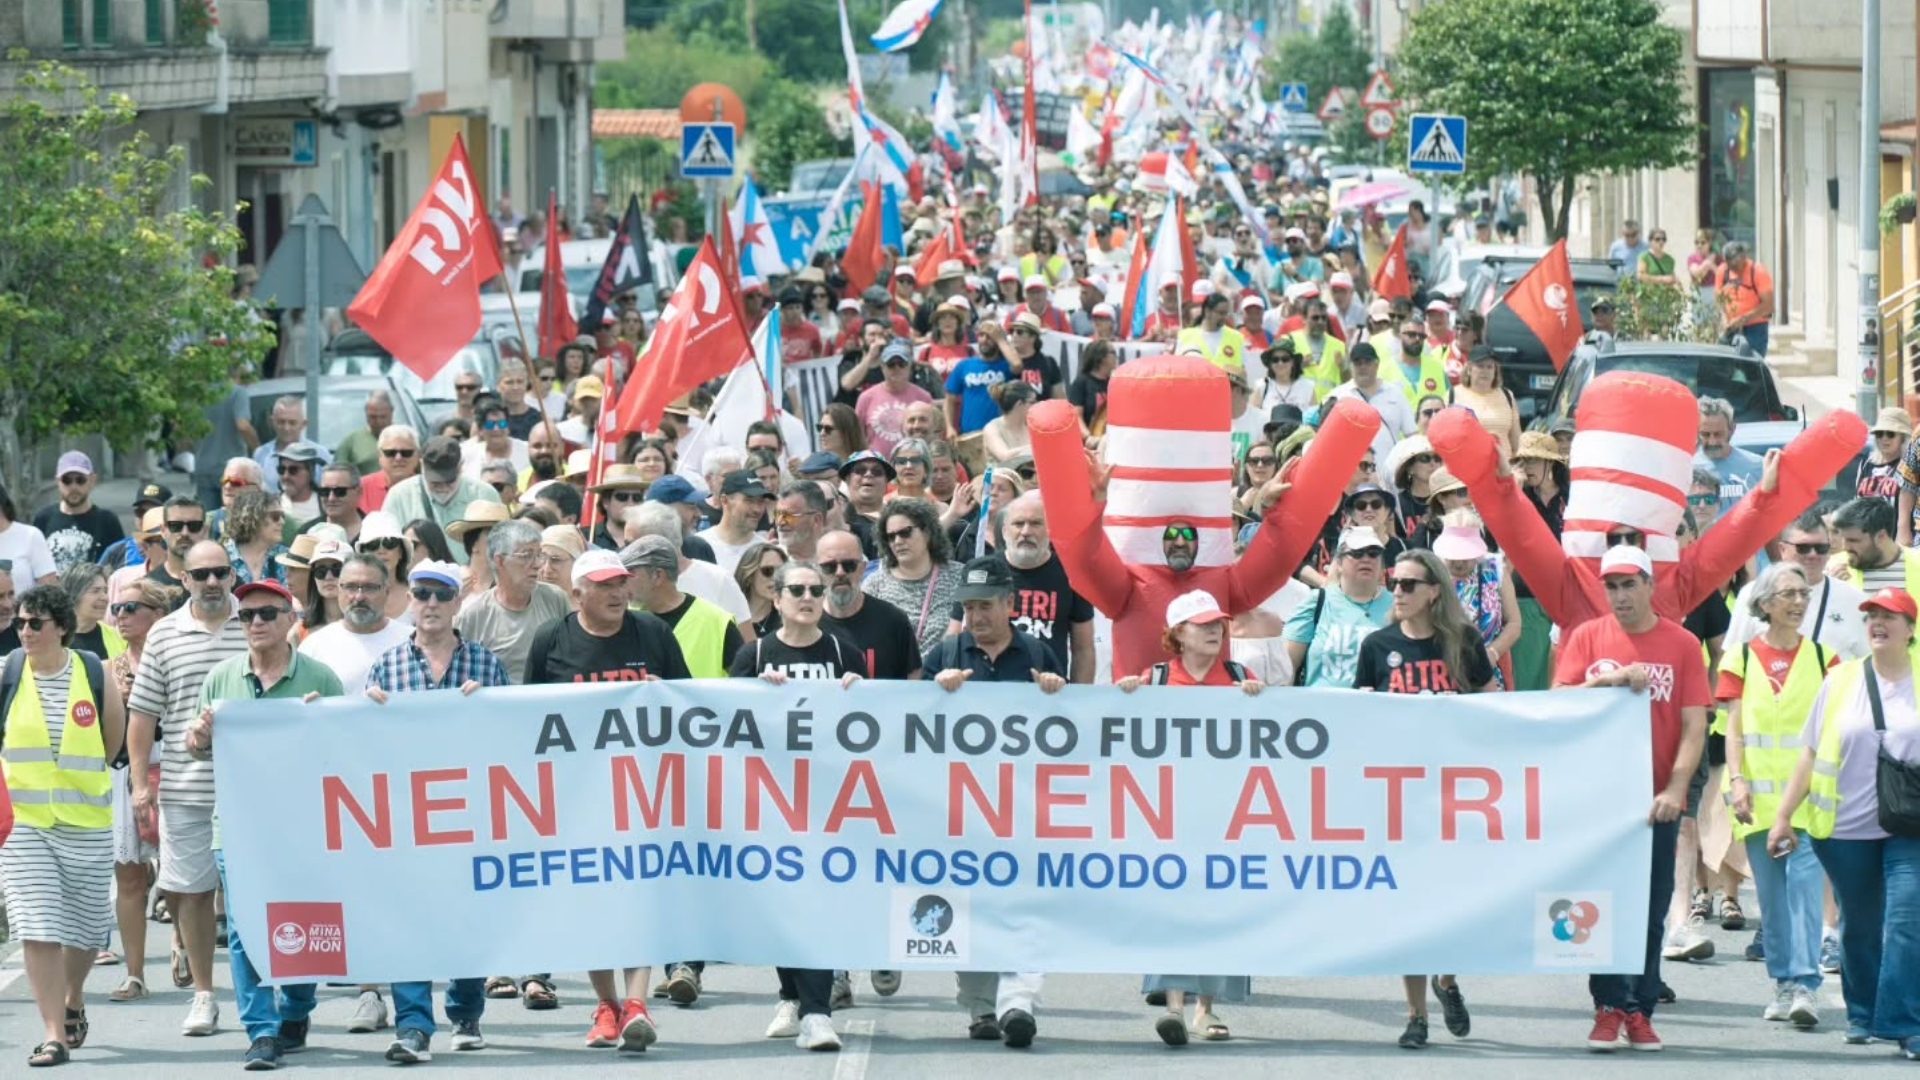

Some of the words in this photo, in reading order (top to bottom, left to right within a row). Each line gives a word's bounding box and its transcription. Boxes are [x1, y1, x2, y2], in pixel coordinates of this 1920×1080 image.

[1856, 475, 1898, 496] ALTRI
[1009, 589, 1058, 621] LTRI
[1322, 622, 1381, 655] ALT
[1389, 659, 1458, 693] ALTR
[1643, 664, 1674, 685] NA
[535, 713, 577, 755] A
[594, 706, 765, 750] AUGA
[786, 697, 813, 751] É
[836, 711, 880, 753] O
[904, 713, 1079, 758] NOSO
[1100, 717, 1329, 759] FUTURO
[323, 762, 557, 851] NEN
[612, 753, 895, 835] MINA
[949, 762, 1174, 840] NEN
[1226, 767, 1541, 842] ALTRI
[472, 840, 805, 892] DEFENDAMOS
[821, 846, 857, 884] O
[875, 848, 1019, 888] NOSO
[1037, 852, 1187, 890] MODO
[1205, 854, 1268, 890] DE
[1284, 855, 1398, 890] VIDA
[309, 927, 341, 937] MINA
[309, 940, 341, 953] NON
[906, 939, 957, 955] PDRA
